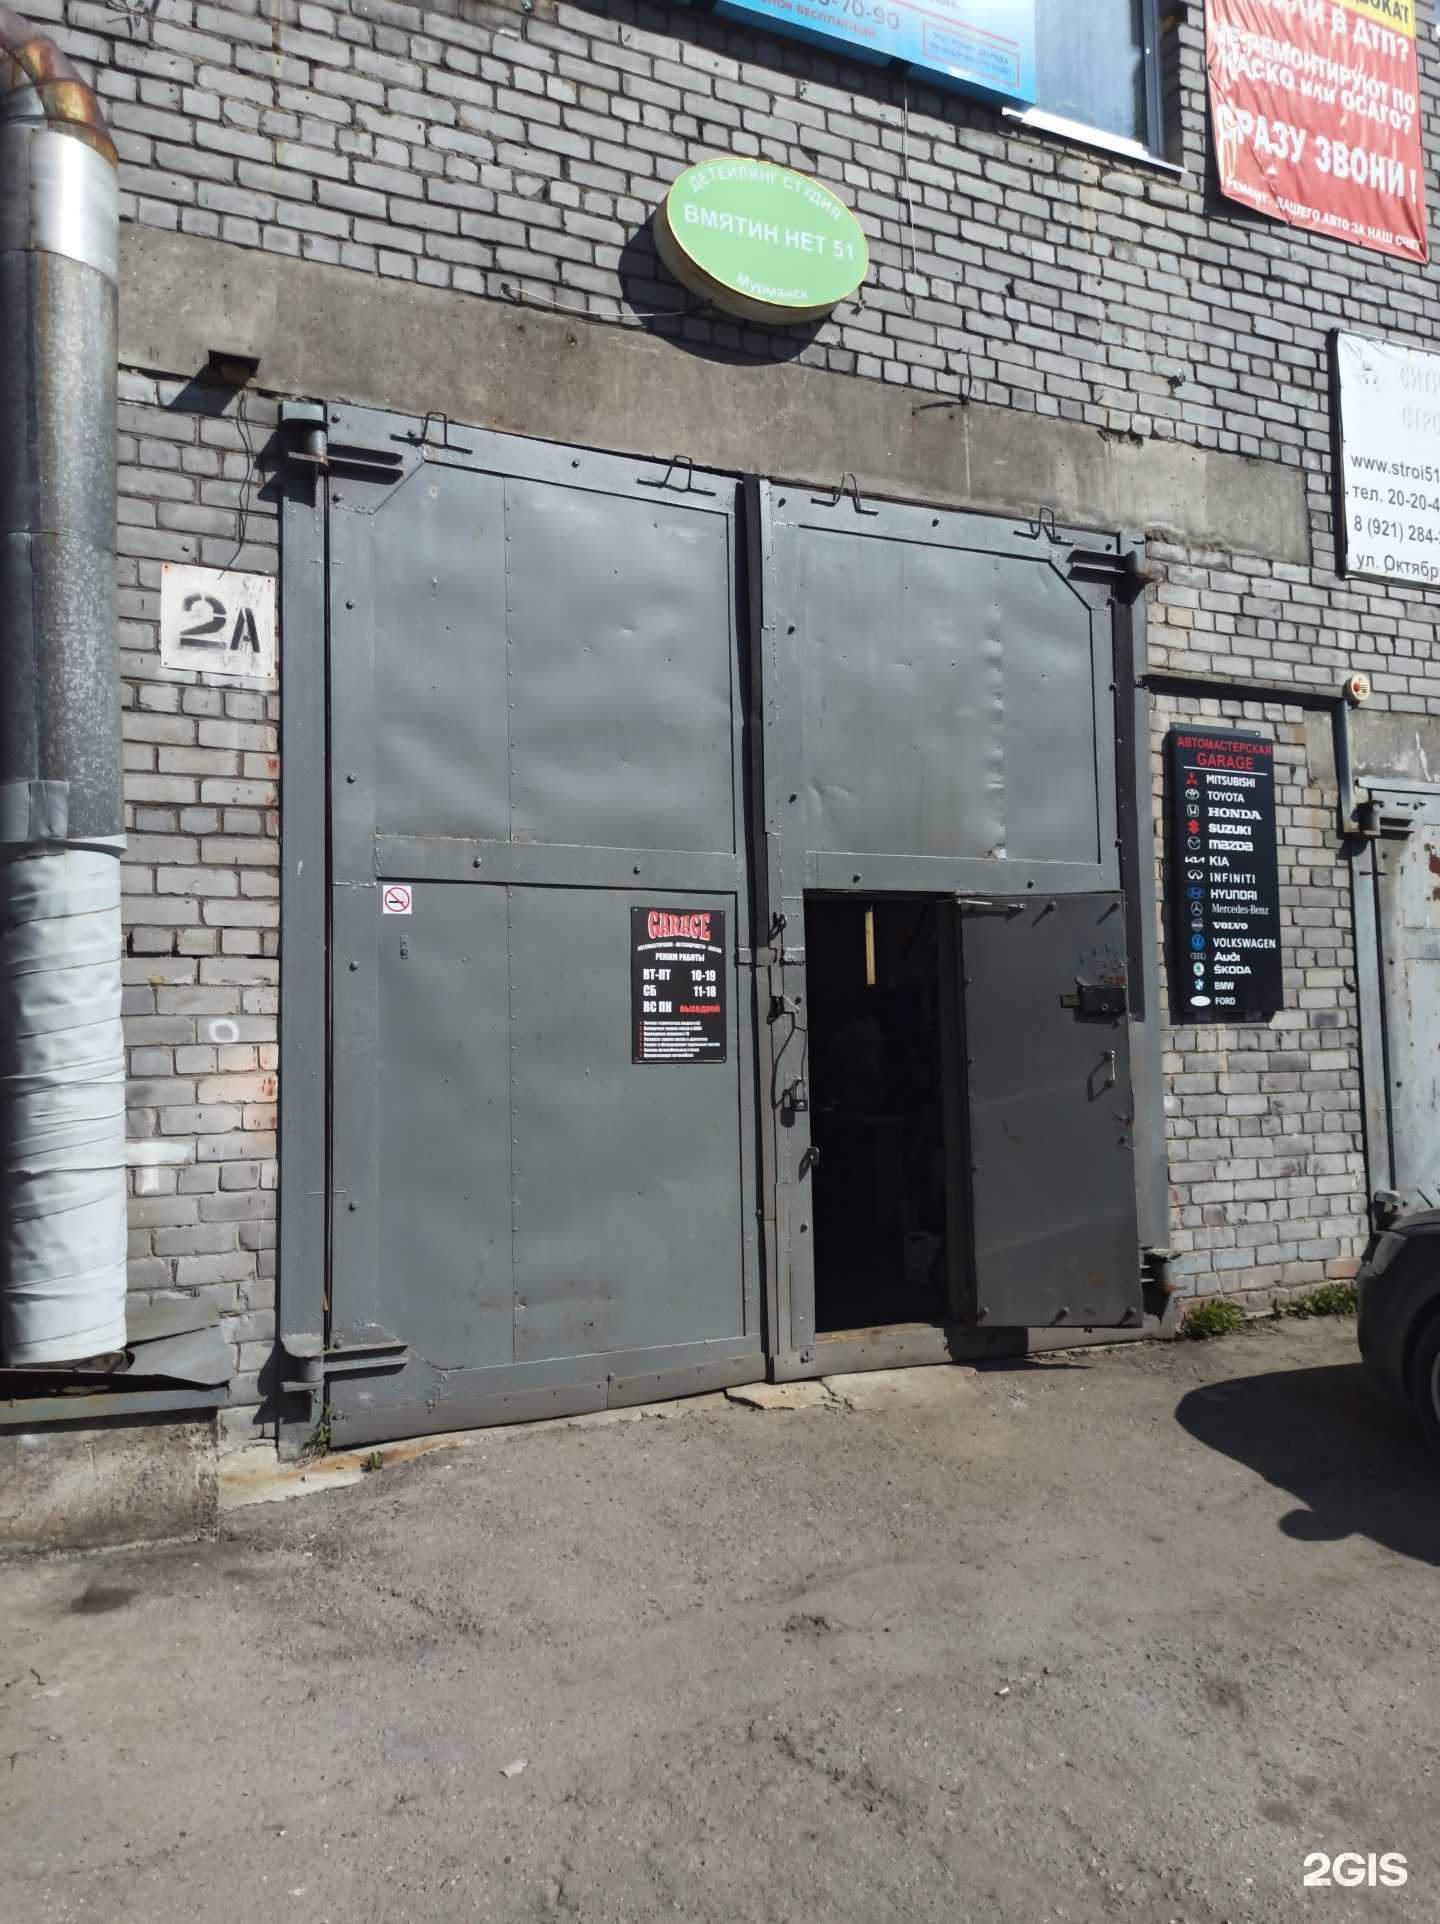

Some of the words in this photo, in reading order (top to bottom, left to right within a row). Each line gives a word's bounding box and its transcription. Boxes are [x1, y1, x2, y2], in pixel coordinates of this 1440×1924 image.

[1221, 49, 1295, 90] КАСКО
[1300, 78, 1336, 104] ИЛИ
[1340, 89, 1412, 134] ОСАГО?
[1392, 88, 1416, 115] ПО
[1216, 104, 1307, 163] СРАЗУ
[1314, 135, 1405, 197] ЗВОНИ
[783, 174, 842, 221] СТУДИЯ
[683, 203, 779, 243] ВМЯТИН
[785, 228, 827, 254] НЕТ
[833, 240, 855, 260] 51
[1322, 212, 1350, 231] АВТО
[1351, 222, 1365, 236] ЗА
[1367, 226, 1393, 244] НАШ
[736, 273, 809, 300] Мурманск
[1352, 485, 1383, 503] тел.
[1354, 515, 1363, 532] 8
[1367, 517, 1403, 544] (921)
[1408, 524, 1440, 544] 284-
[1356, 553, 1380, 570] ул.
[1384, 554, 1440, 581] Октябр
[1176, 737, 1272, 755] АВТОМАСТЕРСКАЯ
[1196, 752, 1254, 770] GARAGE
[1206, 774, 1256, 788] MITSUBISHI
[1207, 790, 1245, 803] TOYOTA
[1208, 807, 1262, 820] HONDA
[1208, 823, 1252, 835] SUZUKI
[1209, 855, 1230, 867] KIA
[1209, 872, 1256, 884] INFINITI
[1210, 888, 1257, 901] HYUNDAI
[1212, 903, 1269, 915] Mercedes-Benz
[648, 911, 710, 941] GARAGE
[1212, 922, 1248, 930] VOLVO
[1213, 938, 1276, 949] VOLKSWAGEN
[679, 953, 705, 962] РАБОТЫ
[1214, 951, 1240, 961] Audi
[643, 968, 671, 981] ВТ-ПТ
[691, 969, 716, 981] 10-19
[643, 984, 656, 997] СБ
[693, 985, 717, 997] 11-18
[1214, 981, 1234, 990] BMW
[643, 1000, 656, 1013] ВС
[659, 1000, 672, 1013] ПН
[1215, 997, 1236, 1005] FORD
